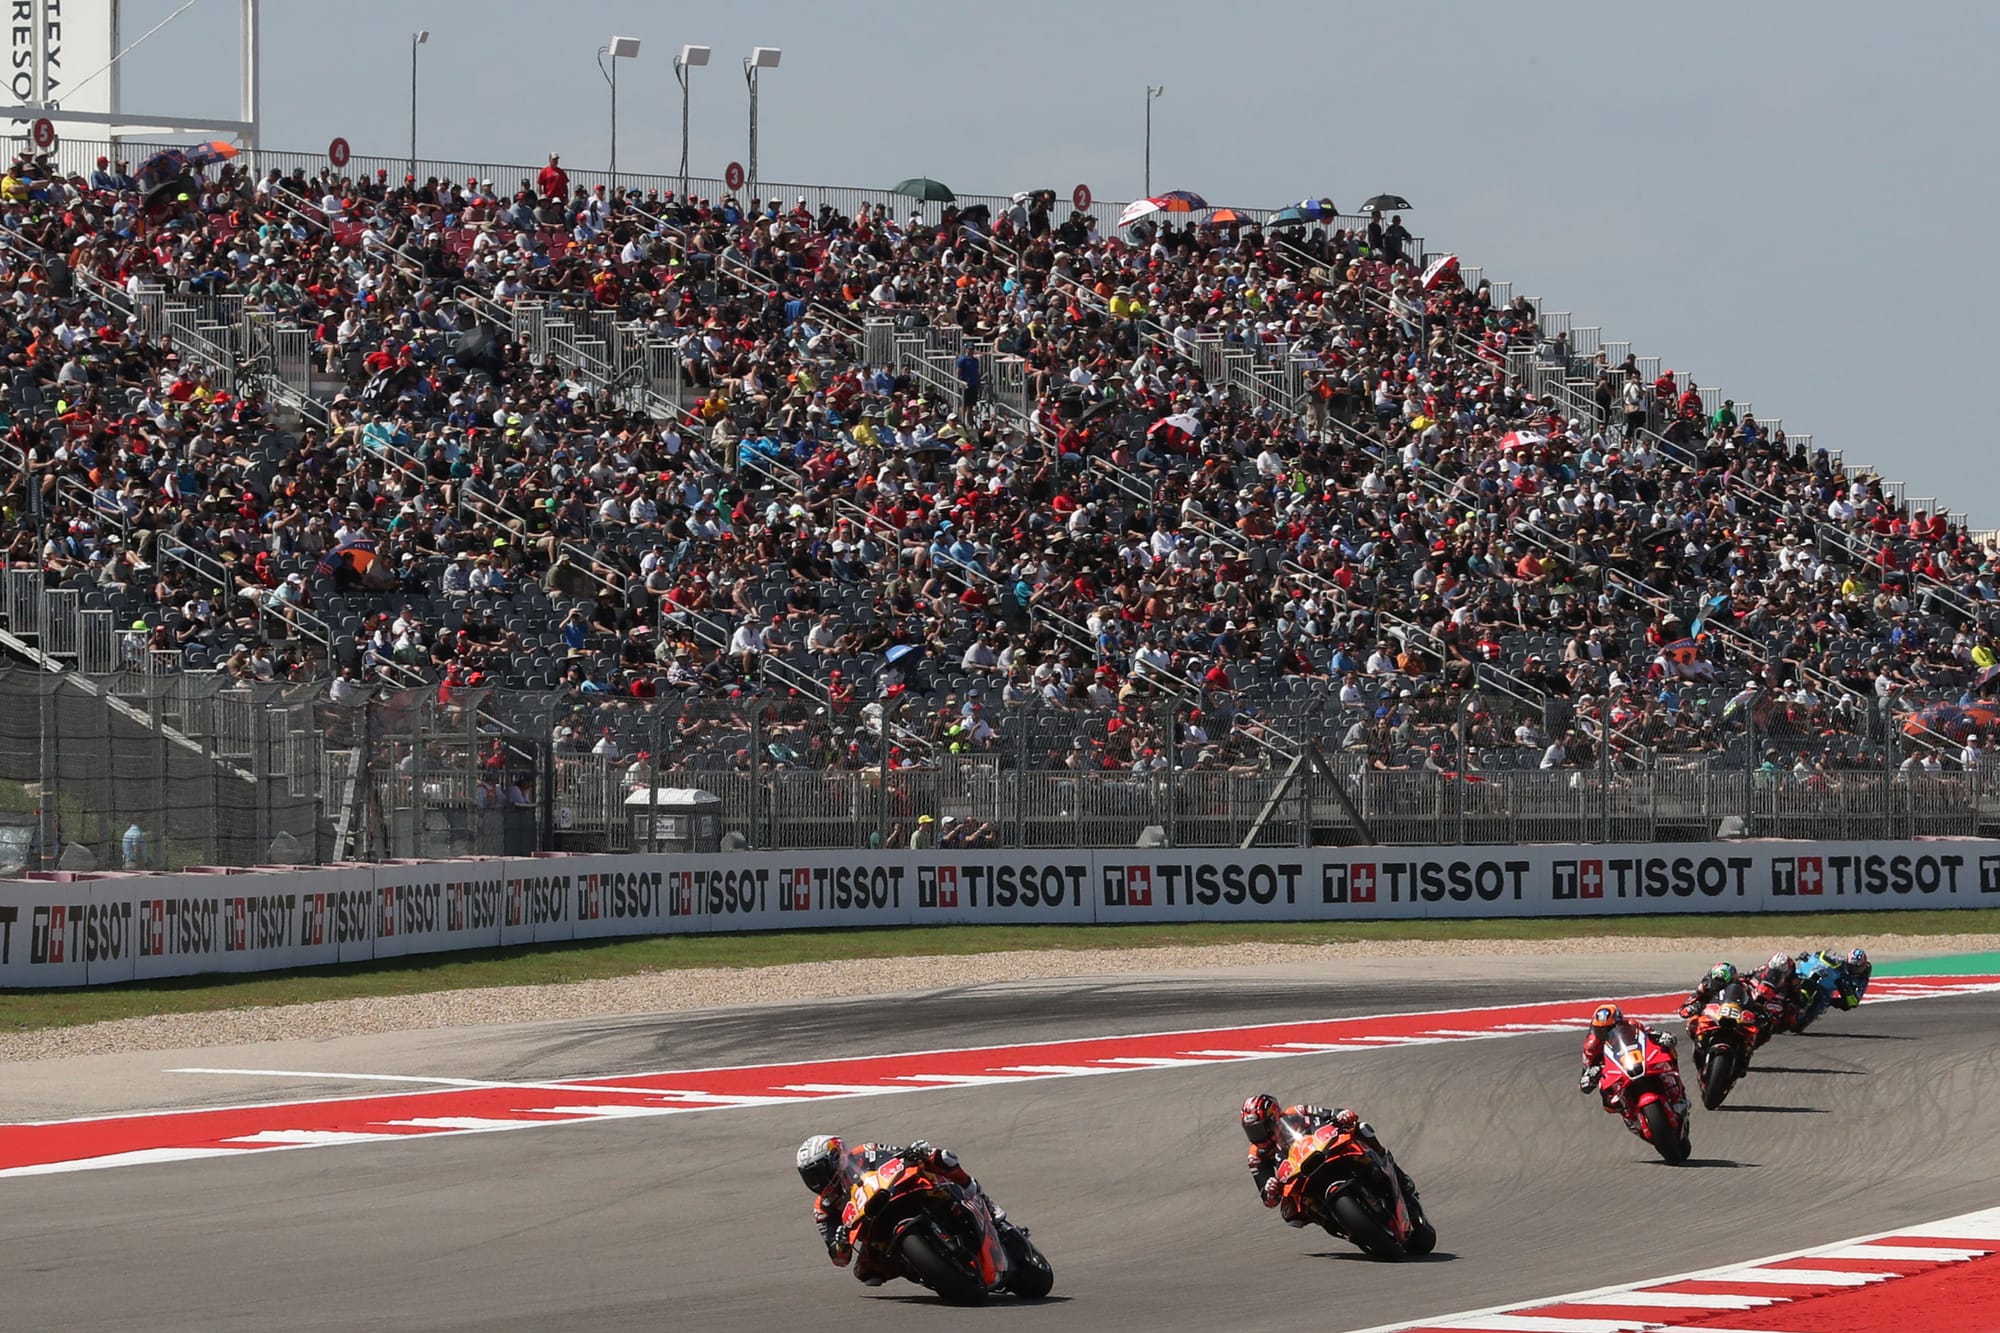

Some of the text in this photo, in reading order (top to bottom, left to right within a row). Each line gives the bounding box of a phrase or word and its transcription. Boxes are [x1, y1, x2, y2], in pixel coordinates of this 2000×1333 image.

[39, 125, 48, 142] 5
[334, 144, 345, 160] 4
[730, 168, 739, 184] 3
[1078, 190, 1087, 206] 2
[600, 872, 662, 918] TISSOT
[695, 869, 769, 914] TISSOT
[813, 866, 904, 911] TISSOT
[961, 864, 1087, 909] TISSOT
[1156, 863, 1302, 907] TISSOT
[1382, 861, 1530, 904] TISSOT
[1608, 857, 1752, 899] TISSOT
[1828, 854, 1964, 897] TISSOT
[247, 895, 295, 950] TISSOT
[327, 891, 371, 944] TISSOT
[396, 882, 440, 935] TISSOT
[464, 880, 500, 930] TISSOT
[524, 876, 570, 925] TISSOT
[69, 902, 131, 962] TISSOT
[166, 898, 218, 955] TISSOT
[1720, 1006, 1740, 1019] 33
